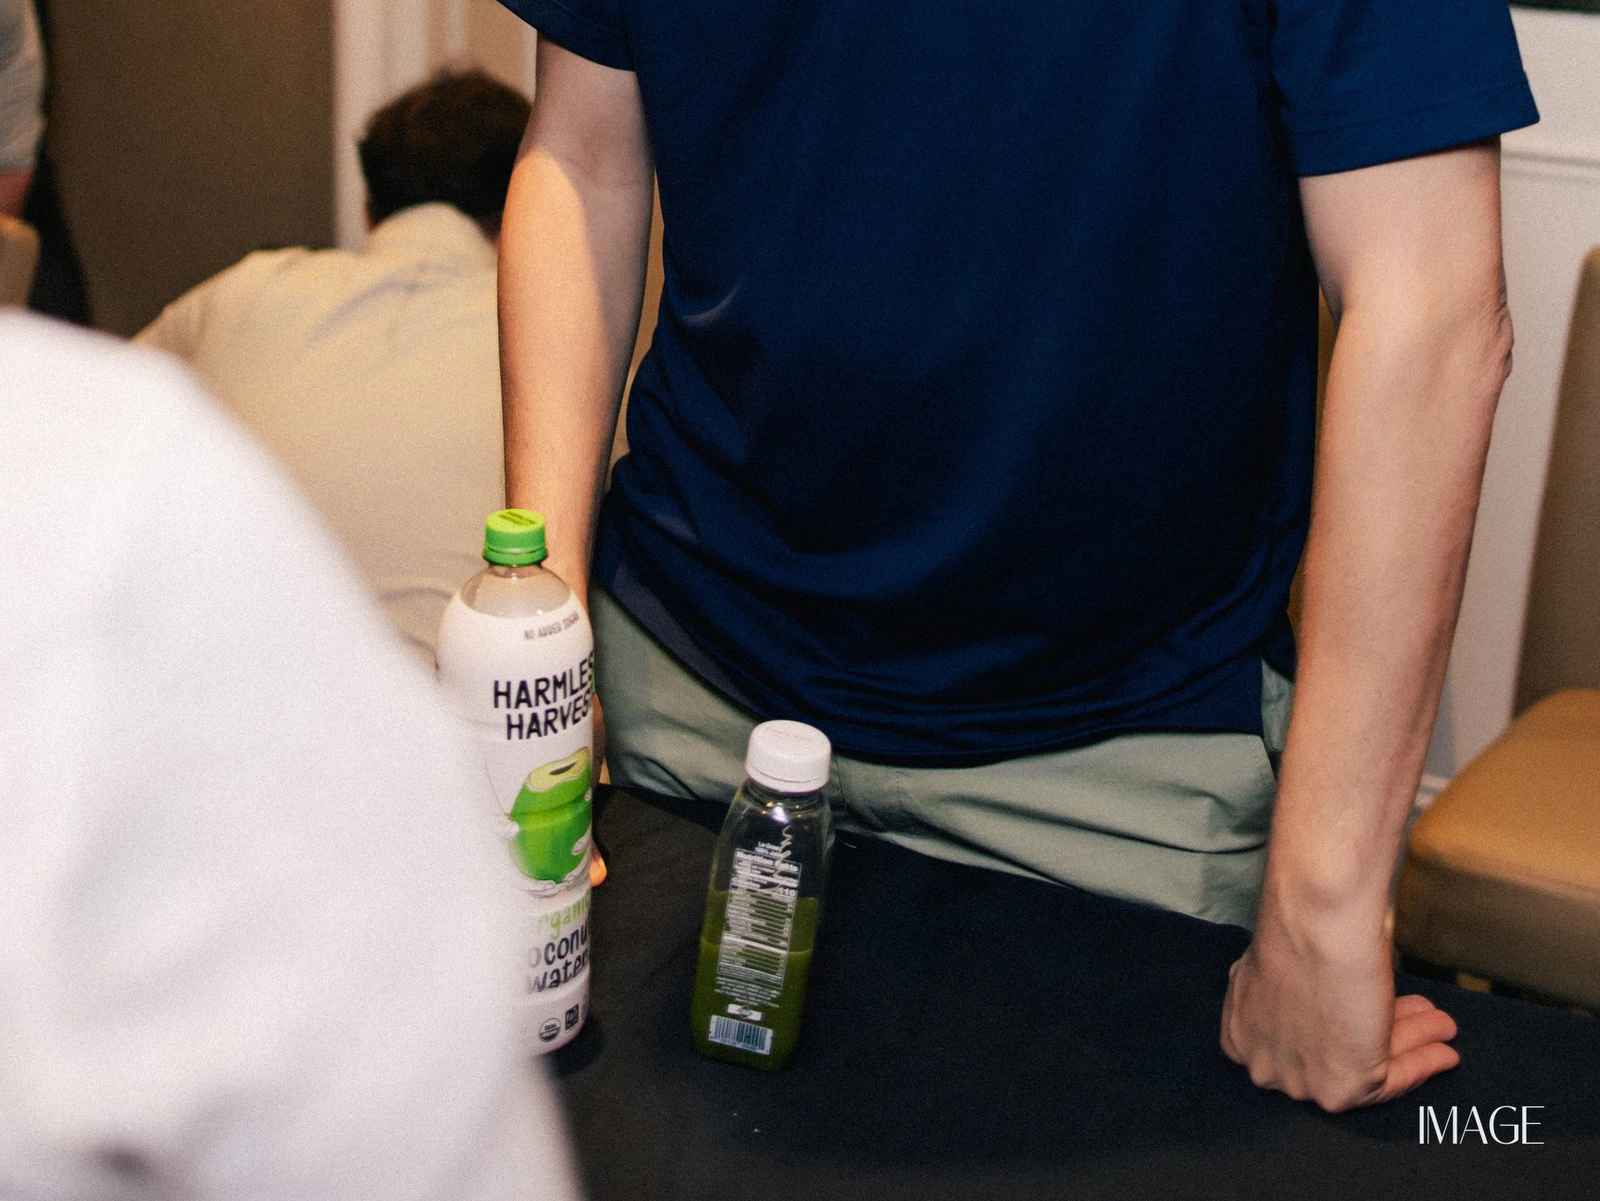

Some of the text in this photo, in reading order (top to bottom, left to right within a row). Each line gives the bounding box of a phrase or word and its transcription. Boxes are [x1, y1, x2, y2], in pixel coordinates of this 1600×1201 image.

[493, 649, 593, 709] HARMLES
[506, 687, 592, 740] HARVES
[528, 919, 588, 968] oconu
